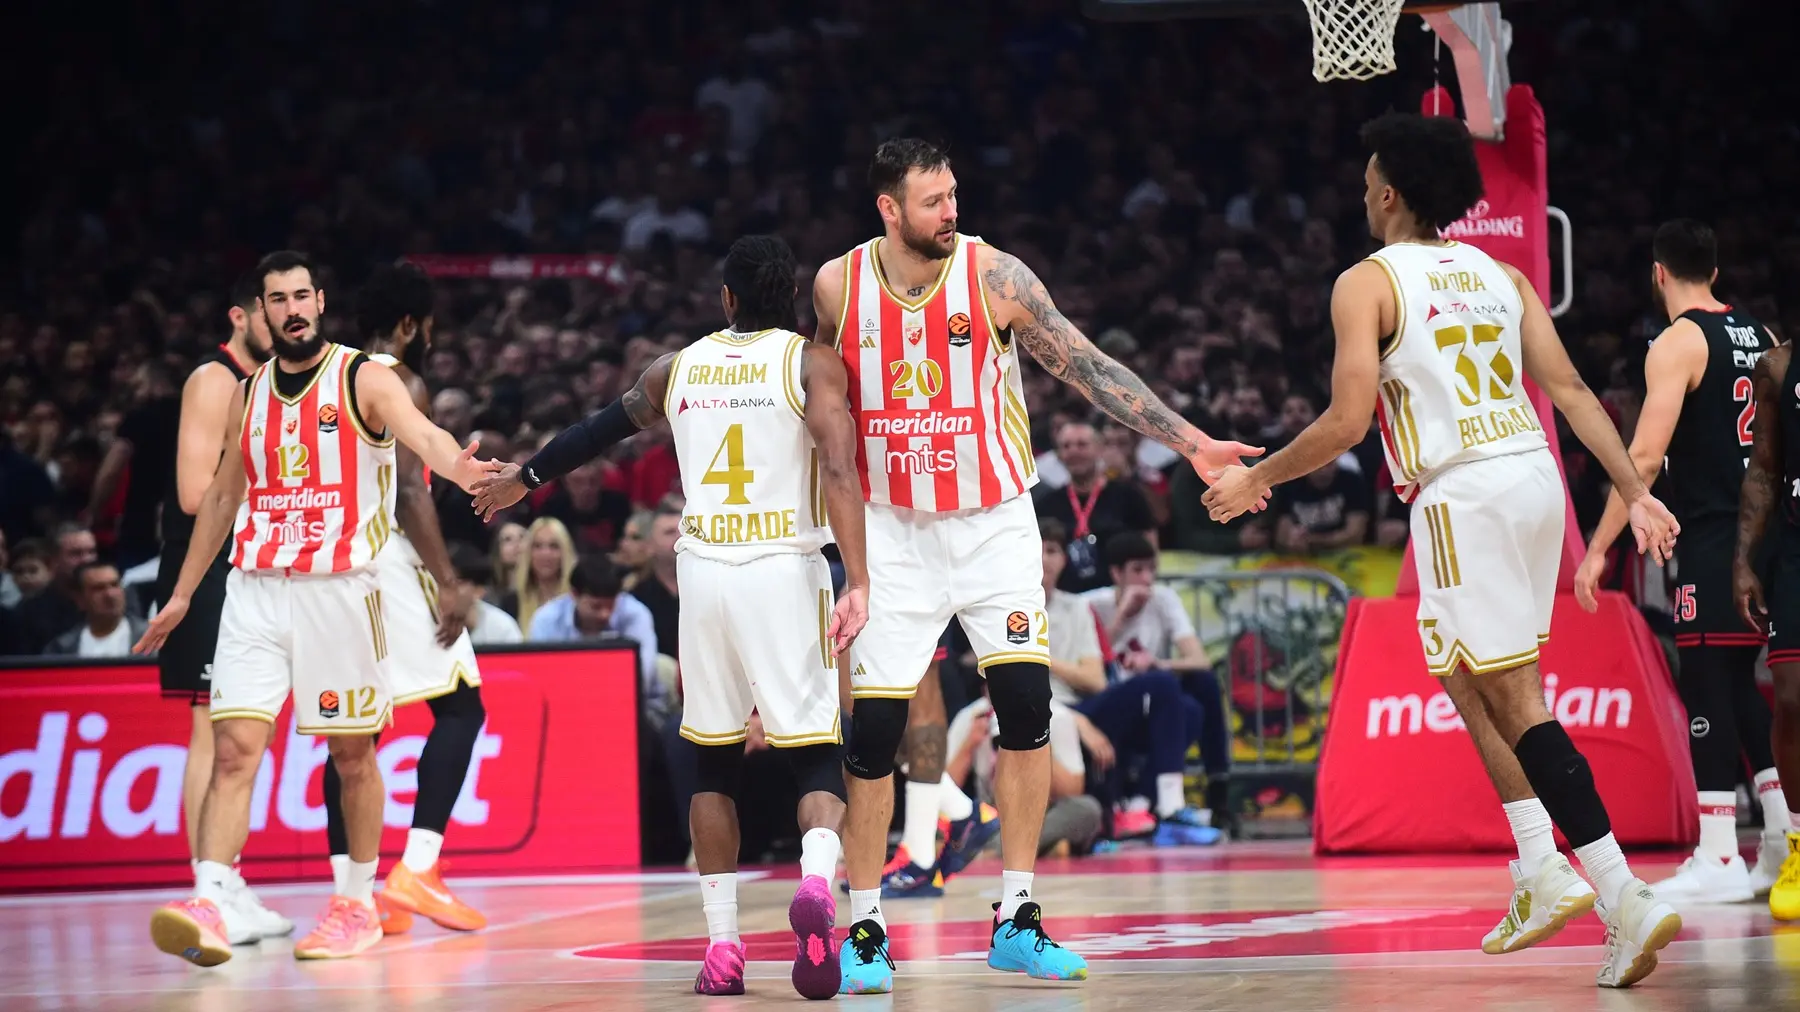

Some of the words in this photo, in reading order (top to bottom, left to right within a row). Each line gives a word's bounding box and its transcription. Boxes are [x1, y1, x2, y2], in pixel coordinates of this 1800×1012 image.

[1436, 216, 1524, 238] PALDING
[687, 363, 768, 385] GRAHAM
[889, 358, 943, 399] 20
[1435, 325, 1514, 407] 33
[868, 411, 972, 434] meridian
[1733, 376, 1757, 446] 2
[275, 443, 310, 480] 12
[701, 424, 754, 504] 4
[886, 444, 957, 474] mts
[257, 488, 341, 511] meridian
[266, 515, 328, 544] mts
[345, 685, 377, 719] 12
[1366, 672, 1632, 739] meian
